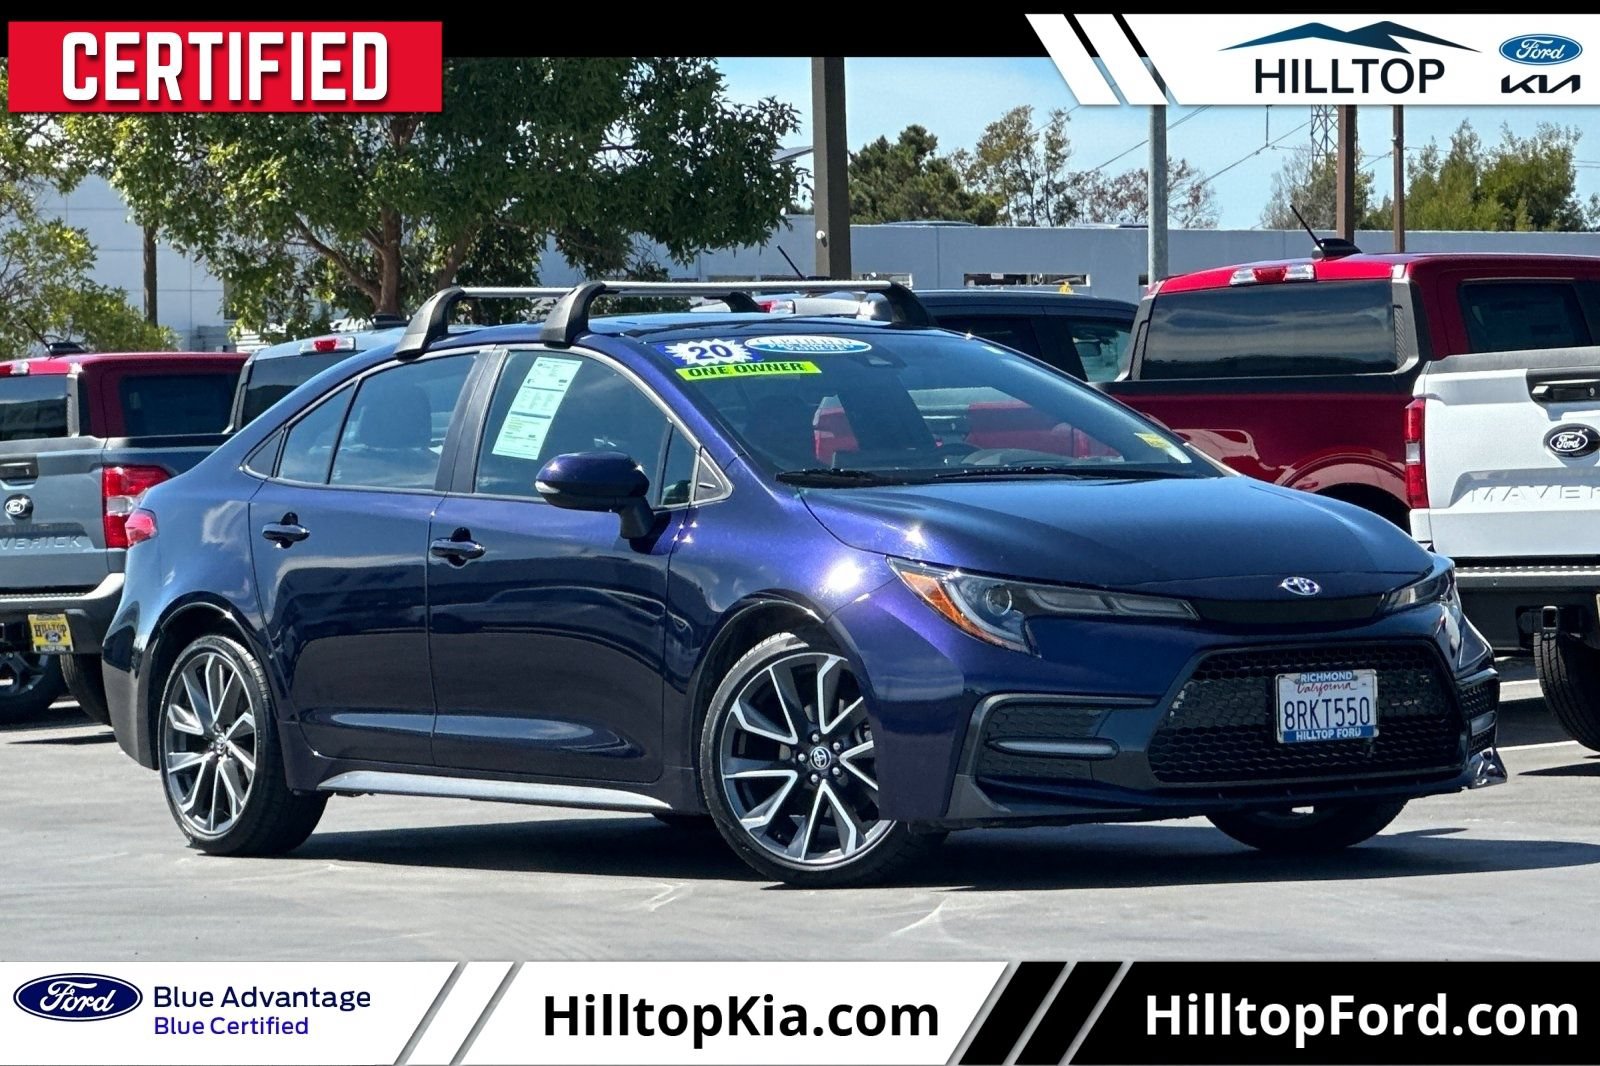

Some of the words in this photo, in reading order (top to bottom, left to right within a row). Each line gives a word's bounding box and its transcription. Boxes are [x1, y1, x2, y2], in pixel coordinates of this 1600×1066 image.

[688, 344, 733, 360] 20
[688, 366, 728, 378] ONE
[734, 362, 804, 374] OWNER
[1556, 433, 1580, 450] Ford
[1300, 671, 1353, 682] RICHMOND
[1297, 682, 1357, 697] California
[1284, 696, 1370, 730] 8RKT550
[1296, 729, 1334, 741] HILLTOP
[1336, 727, 1362, 738] FORD
